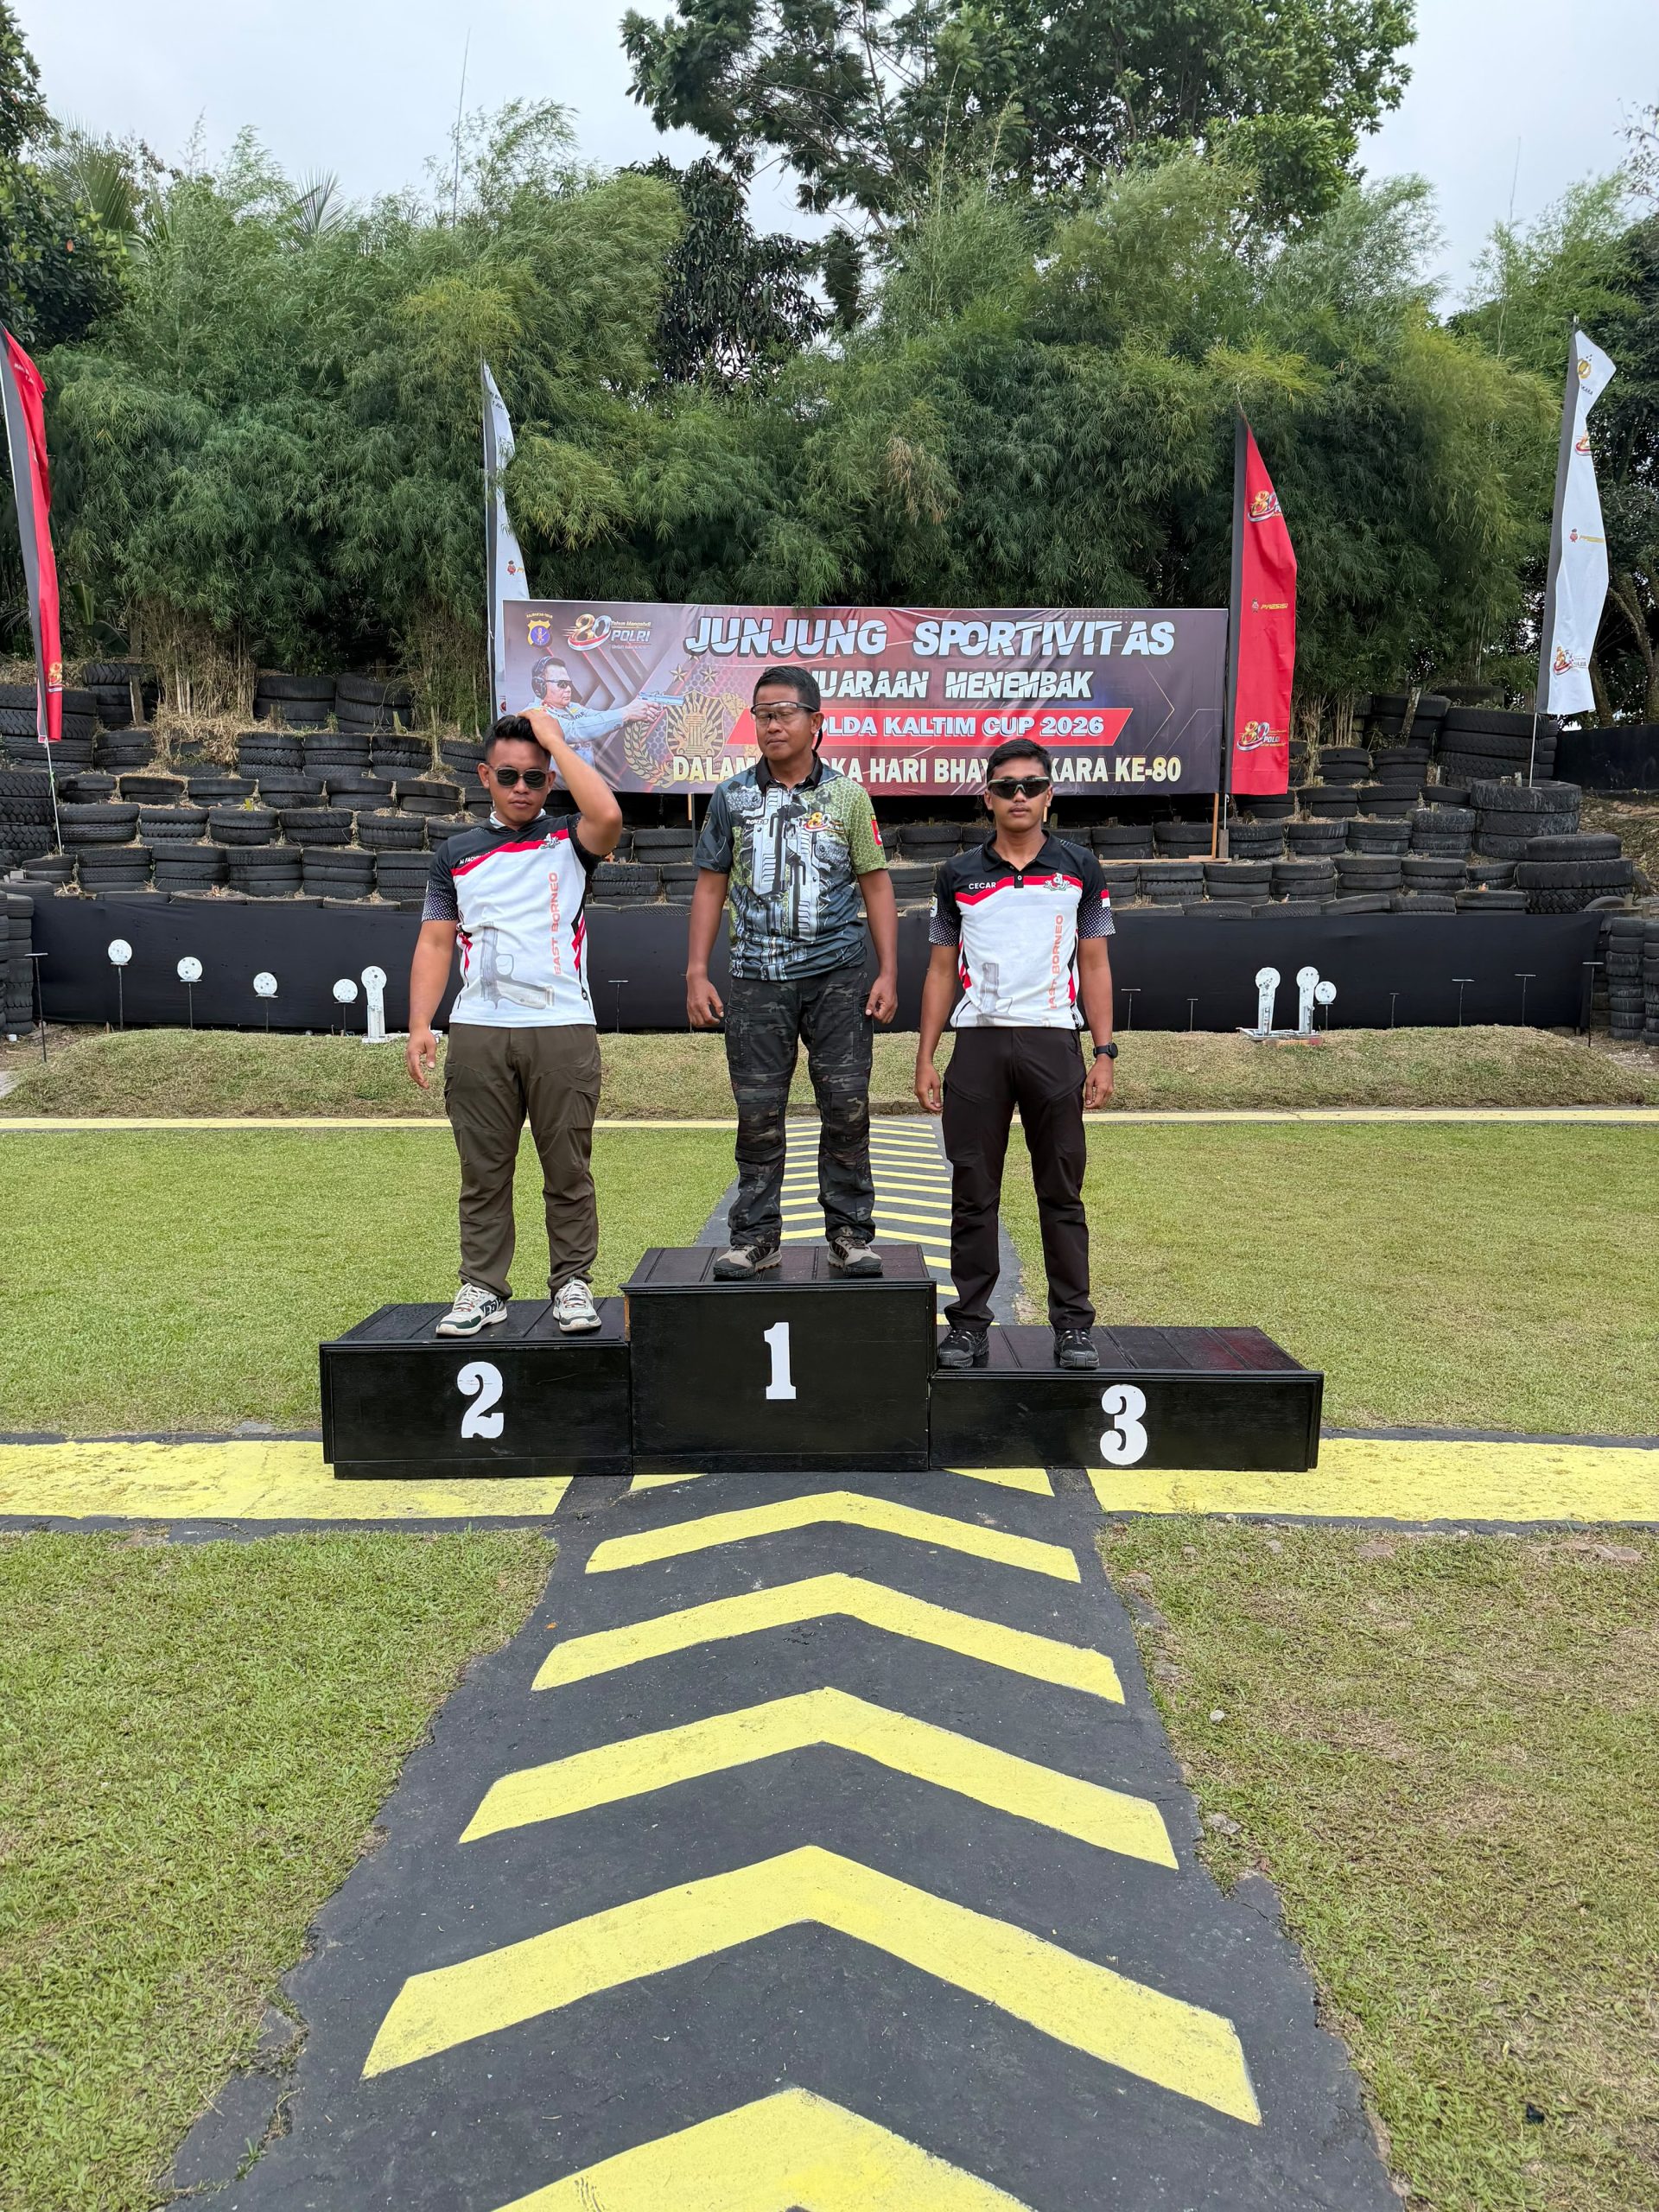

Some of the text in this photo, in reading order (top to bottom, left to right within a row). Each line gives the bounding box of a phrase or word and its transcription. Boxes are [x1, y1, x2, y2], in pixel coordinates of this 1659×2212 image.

[611, 630, 651, 642] POLRI
[684, 617, 1175, 657] JUNJUNG SPORTIVITAS
[811, 671, 1094, 698] UARAAN MENEMBAK
[883, 716, 976, 737] KALTIM
[982, 715, 1035, 737] CUP
[1039, 715, 1104, 737] 2026
[672, 756, 757, 782] DALAM
[869, 757, 927, 784] HARI
[1116, 756, 1181, 783] KE-80
[549, 872, 562, 976] EAST BORNEO
[1052, 914, 1064, 975] BORNEO
[763, 1322, 797, 1400] 1
[456, 1362, 505, 1440] 2
[1100, 1384, 1147, 1465] 3
